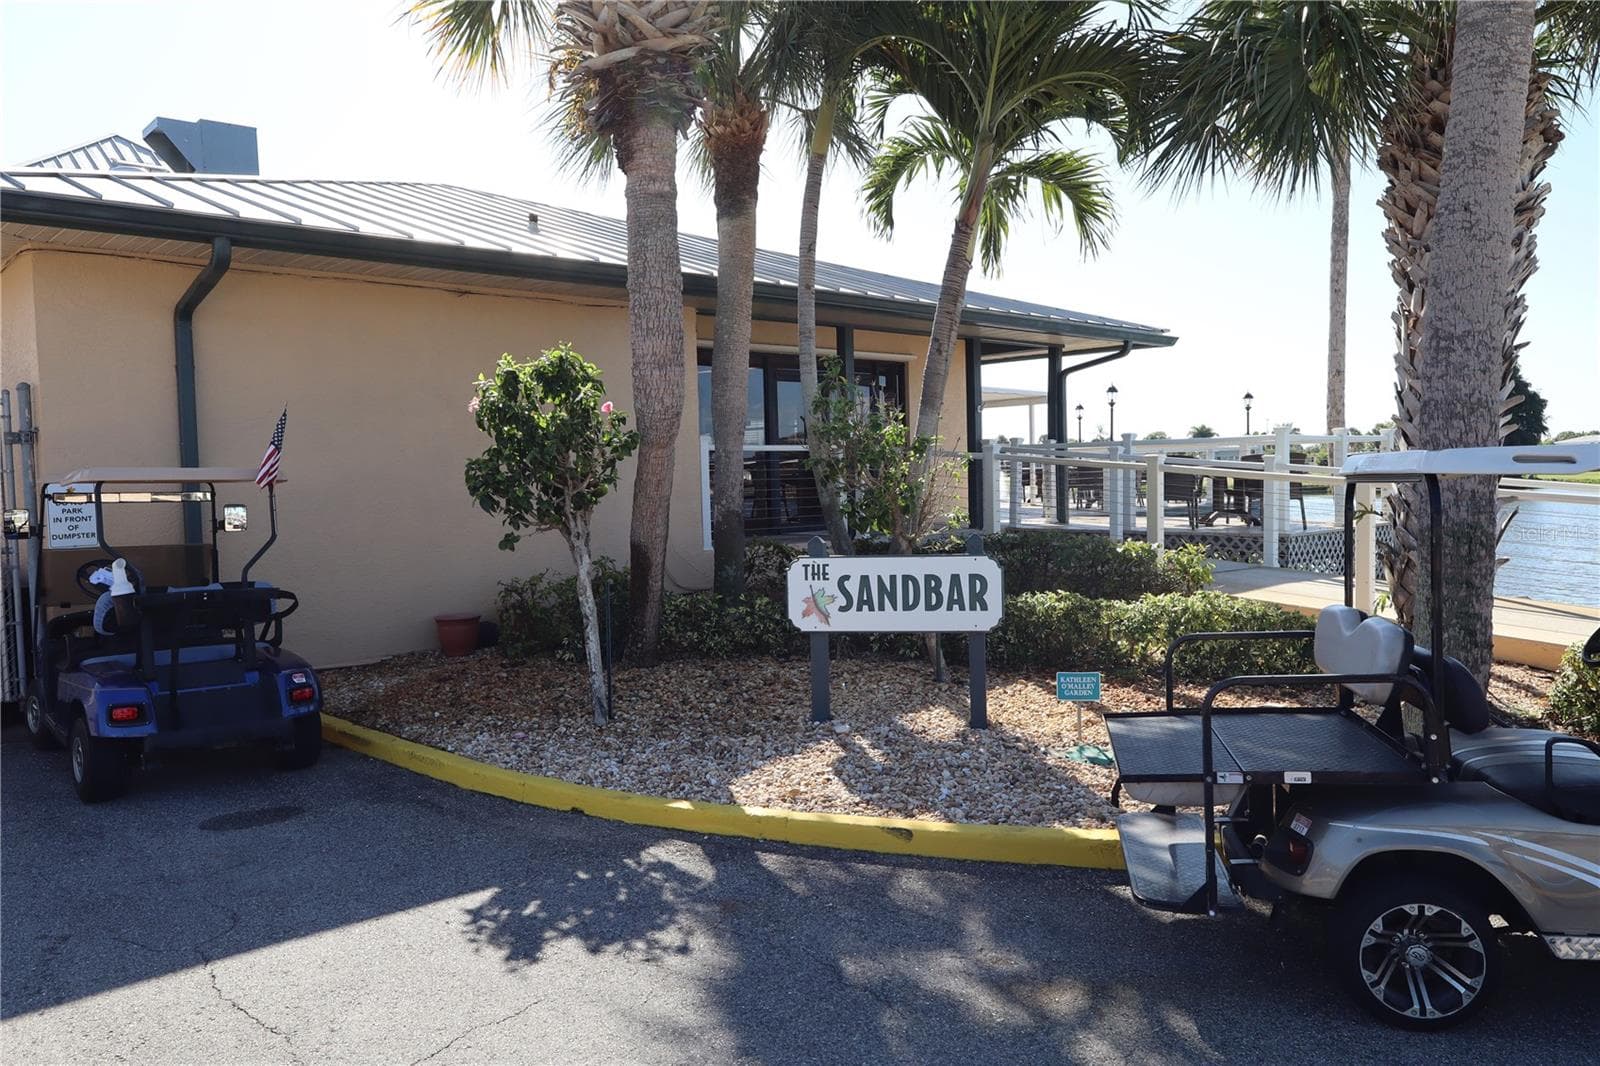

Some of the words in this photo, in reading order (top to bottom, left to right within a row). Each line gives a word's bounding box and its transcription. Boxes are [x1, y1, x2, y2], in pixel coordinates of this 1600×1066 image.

[65, 515, 92, 523] FRONT
[52, 533, 96, 541] DUMPSTER
[802, 563, 830, 581] THE
[837, 573, 989, 613] SANDBAR
